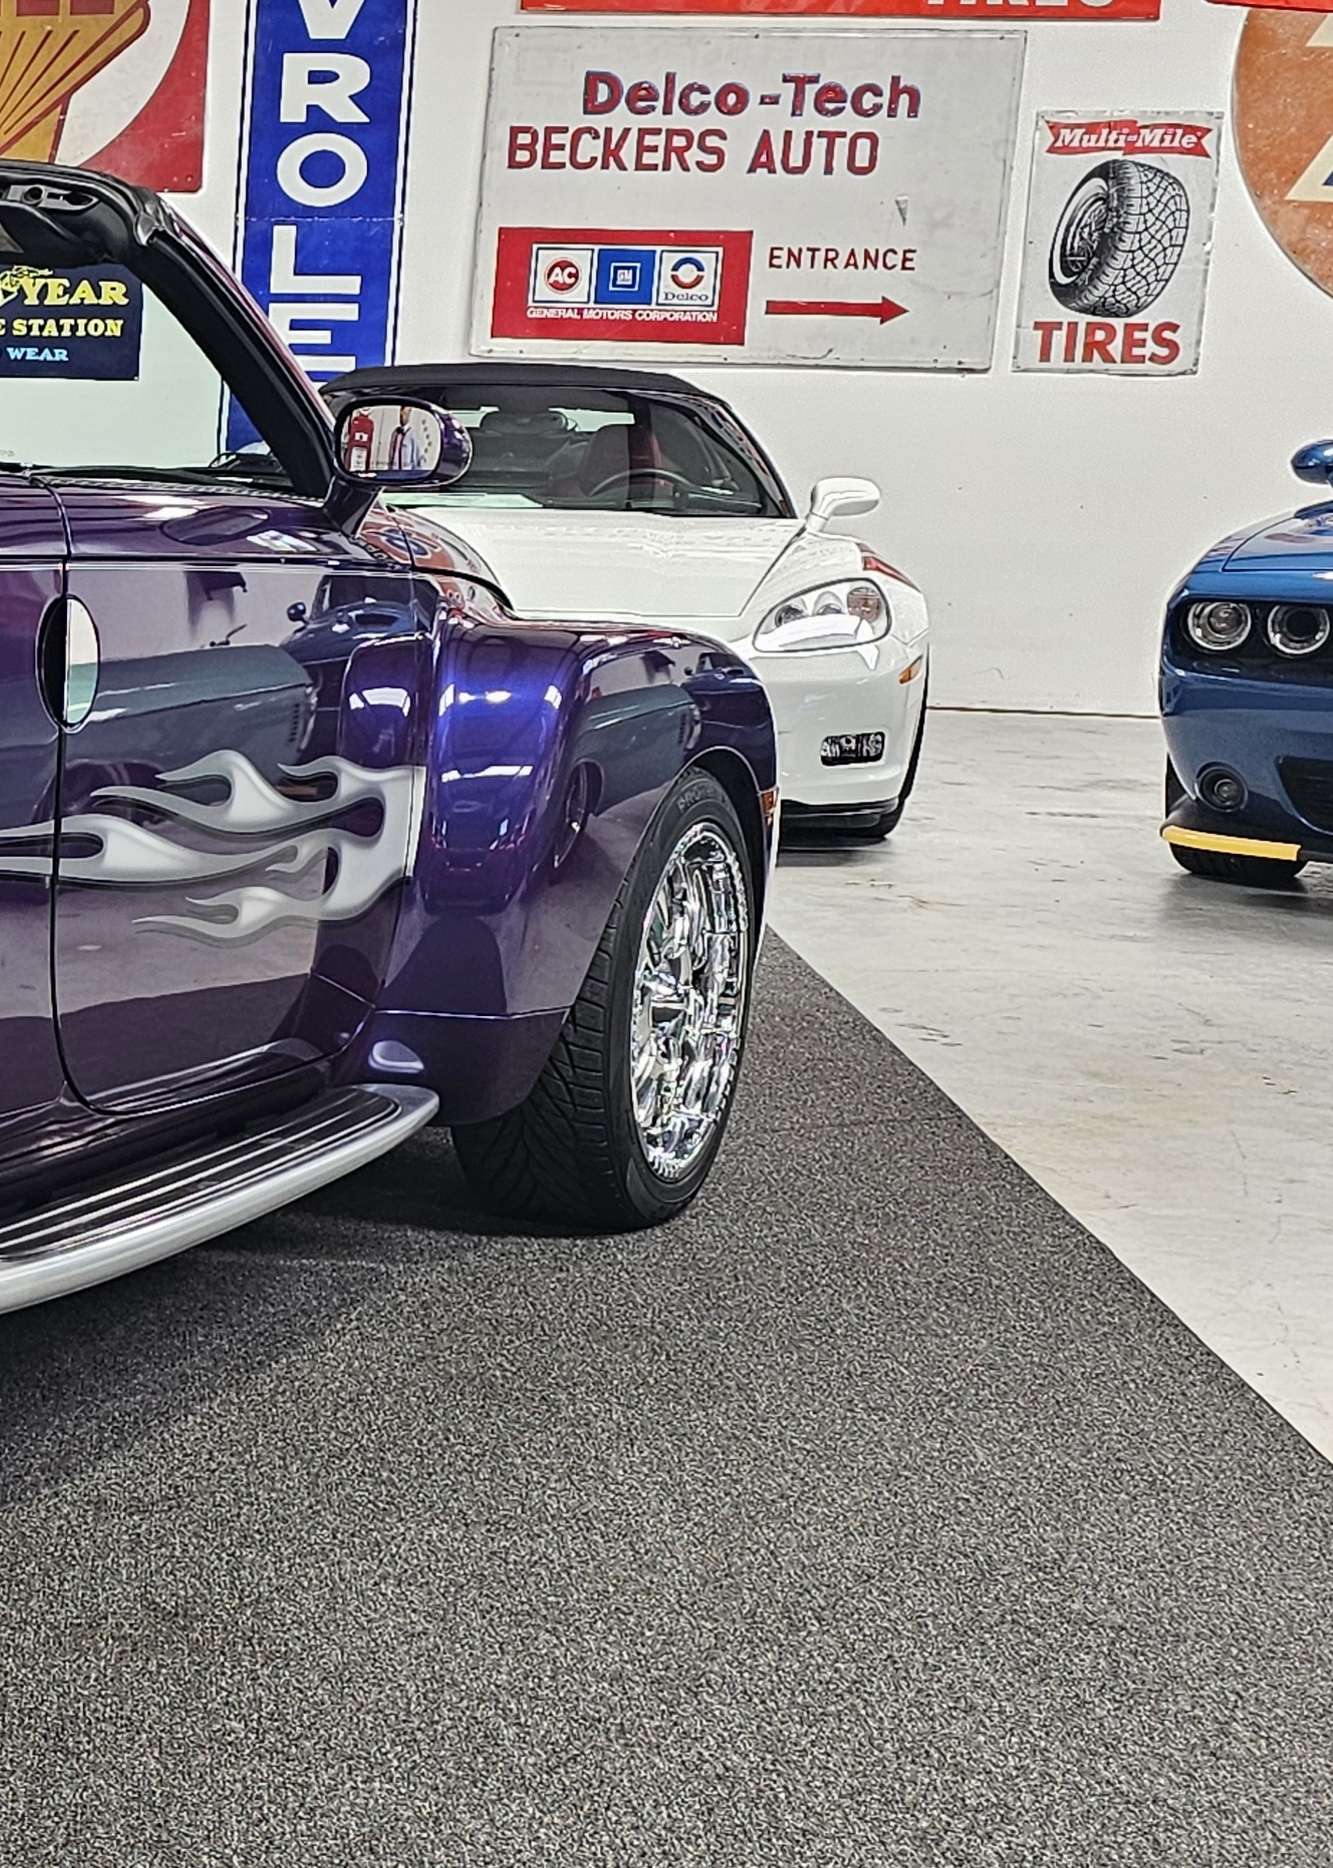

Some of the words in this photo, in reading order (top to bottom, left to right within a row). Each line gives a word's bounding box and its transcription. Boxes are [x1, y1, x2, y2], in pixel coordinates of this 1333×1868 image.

[1053, 127, 1199, 150] Multi-Mile
[507, 125, 728, 173] BECKERS
[746, 128, 880, 177] AUTO
[768, 246, 918, 271] ENTRANCE
[546, 265, 578, 285] AC
[663, 291, 709, 302] Delco
[527, 307, 581, 320] GENERAL
[583, 309, 632, 321] MOTORS
[635, 310, 718, 323] CORPORATION
[12, 318, 124, 337] STATION
[1032, 320, 1181, 366] TIRES
[7, 345, 69, 362] WEAR
